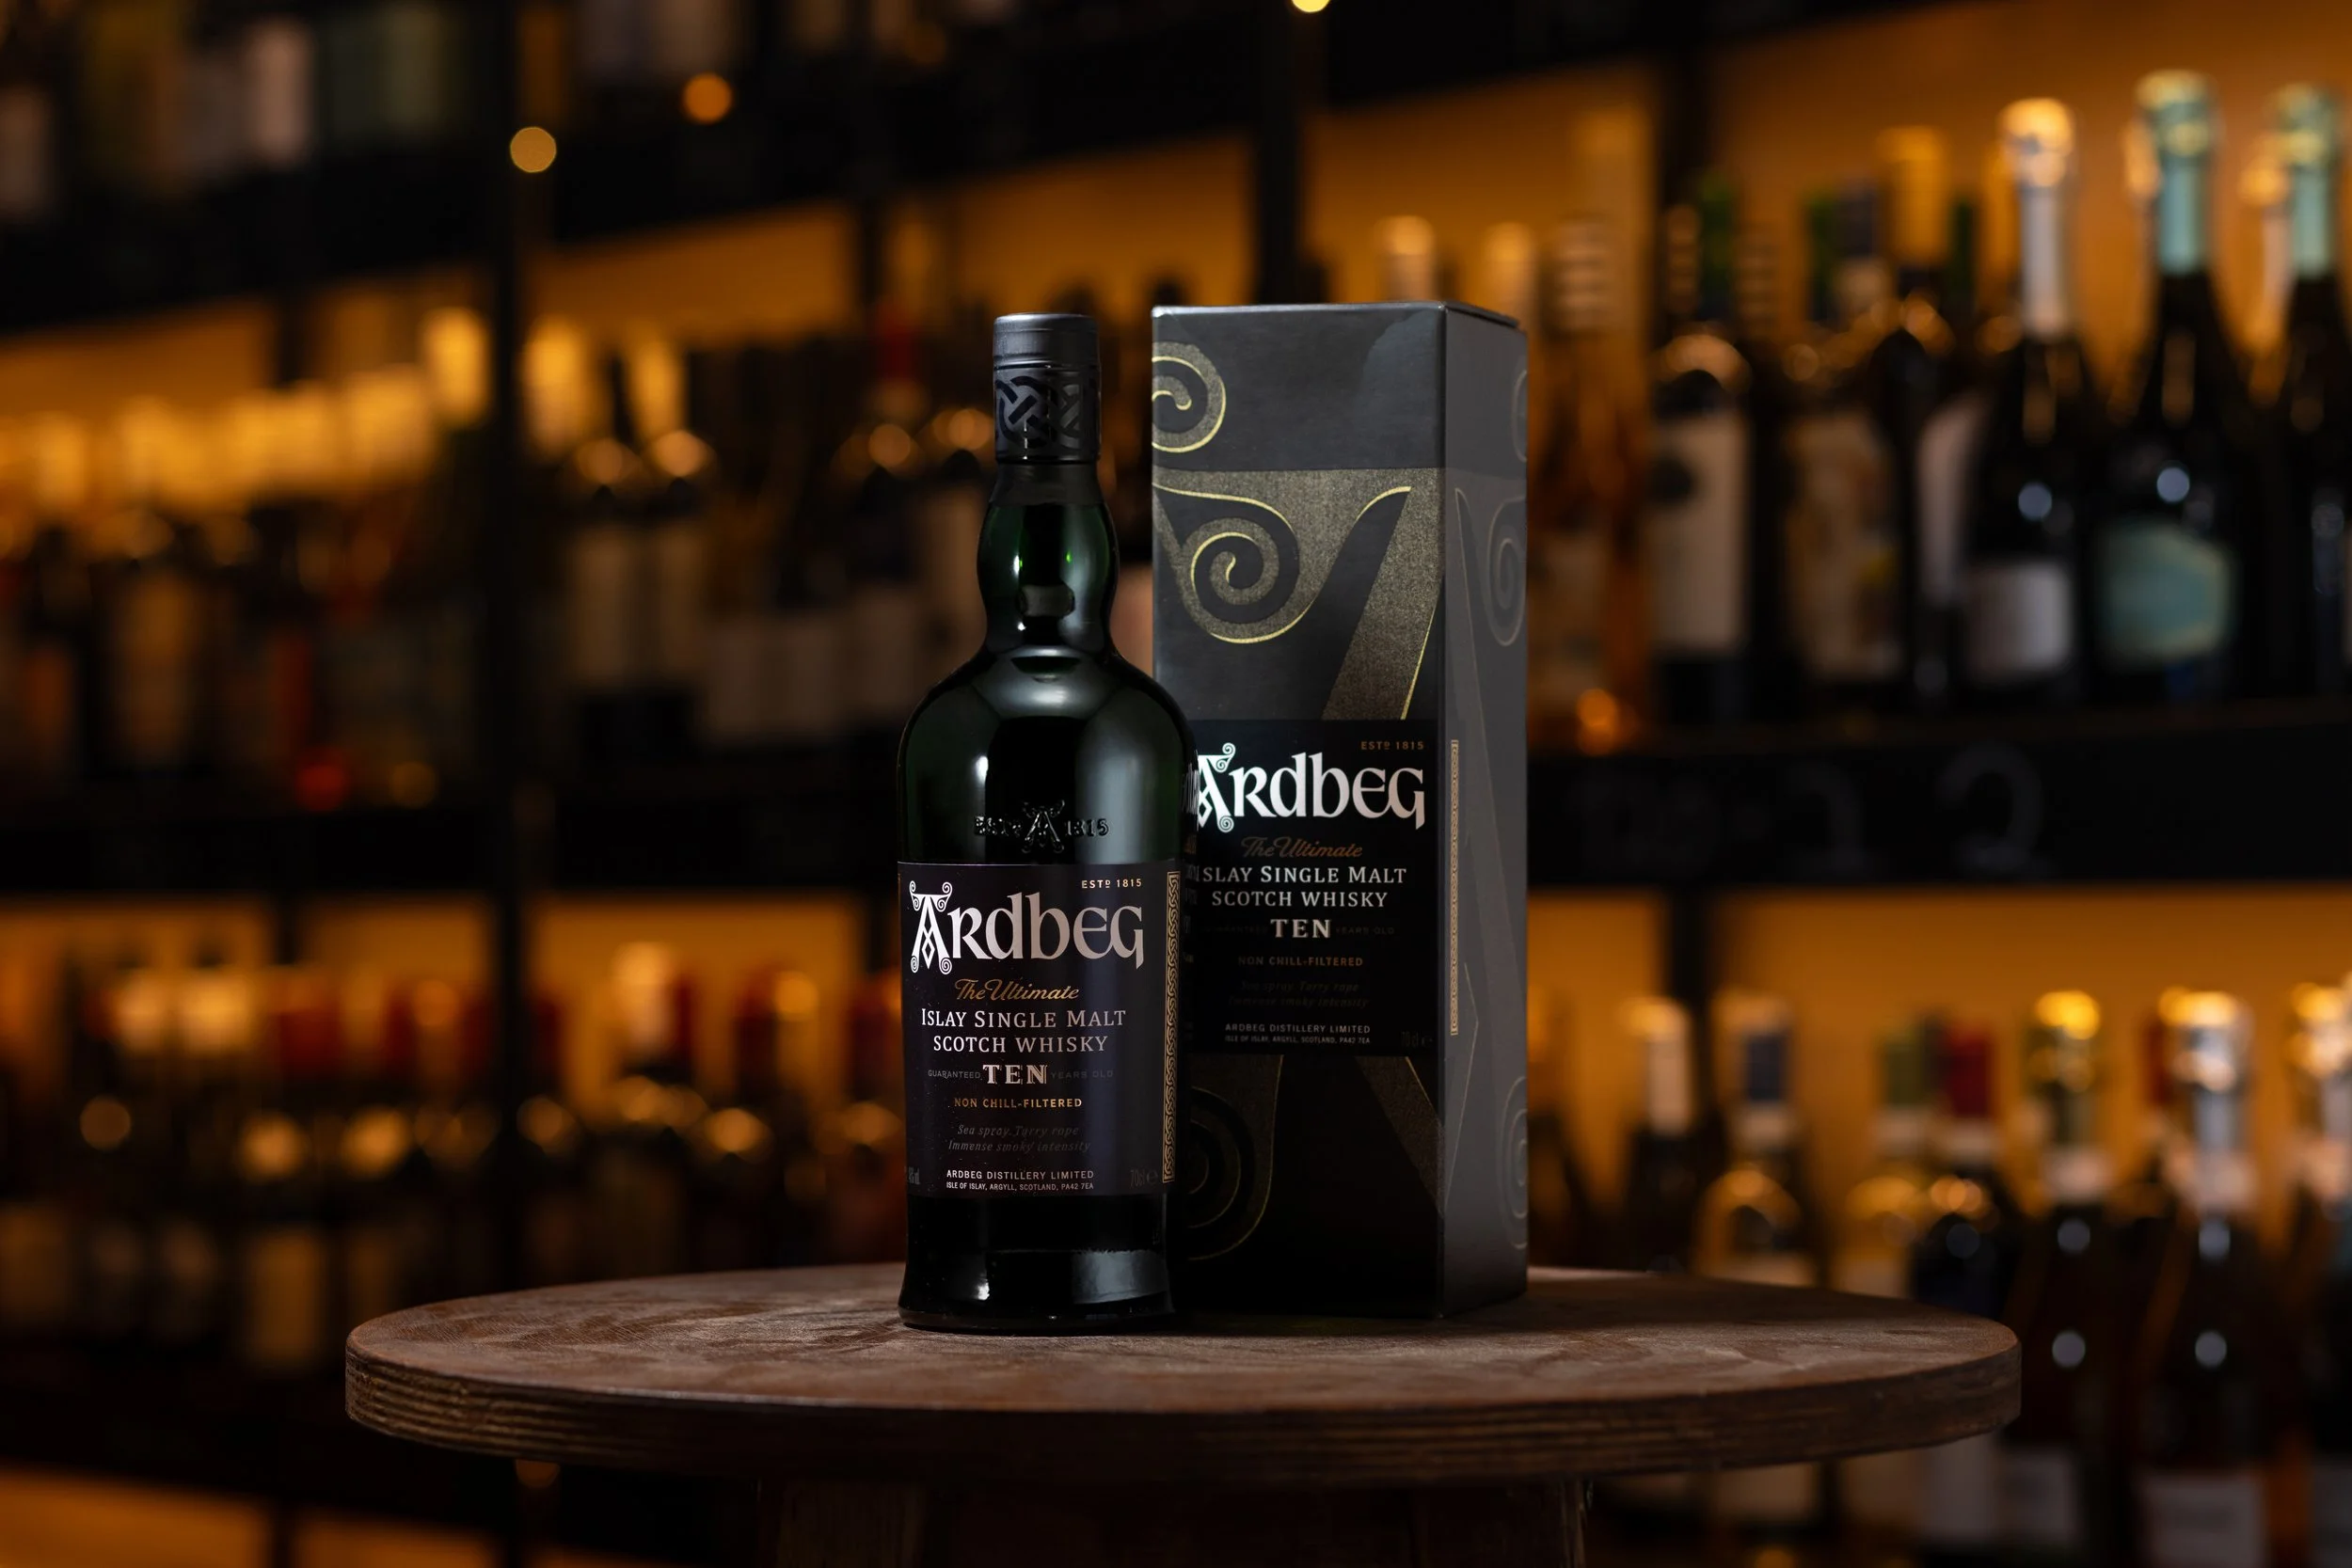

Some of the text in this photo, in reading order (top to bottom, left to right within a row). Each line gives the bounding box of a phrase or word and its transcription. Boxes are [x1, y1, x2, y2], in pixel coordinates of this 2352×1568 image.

[1395, 740, 1424, 751] 1815
[1065, 817, 1109, 837] 1815
[1241, 836, 1363, 858] The Ultimate
[1260, 865, 1340, 883] SINGLE
[1348, 865, 1407, 884] MALT
[1116, 878, 1142, 888] 1815
[1211, 890, 1390, 908] SCOTCH WHISKY
[1270, 918, 1332, 939] TEN
[1237, 956, 1364, 967] NON CHILL-FILTERED
[955, 979, 1080, 1001] The Ultimate
[922, 1008, 1126, 1028] ISLAY SINGLE MALT
[1225, 1023, 1372, 1034] ARDBEG DISTILLERY LIMITED
[933, 1036, 1108, 1053] SCOTCH WHISKY
[928, 1064, 1115, 1085] GUARANTEED TEN YEARS OLD
[954, 1098, 1083, 1109] NON CHILL-FILTERED
[957, 1125, 976, 1135] Sea
[1052, 1127, 1080, 1138] rope
[947, 1139, 1091, 1153] Immense smoky intensity
[946, 1169, 1094, 1180] ARDBEG DISTILLERY LIMITED
[946, 1180, 959, 1189] ISLE
[990, 1183, 1018, 1192] ARGYLL,
[1019, 1183, 1059, 1192] SCOTLAND,
[1081, 1181, 1094, 1190] 7EA
